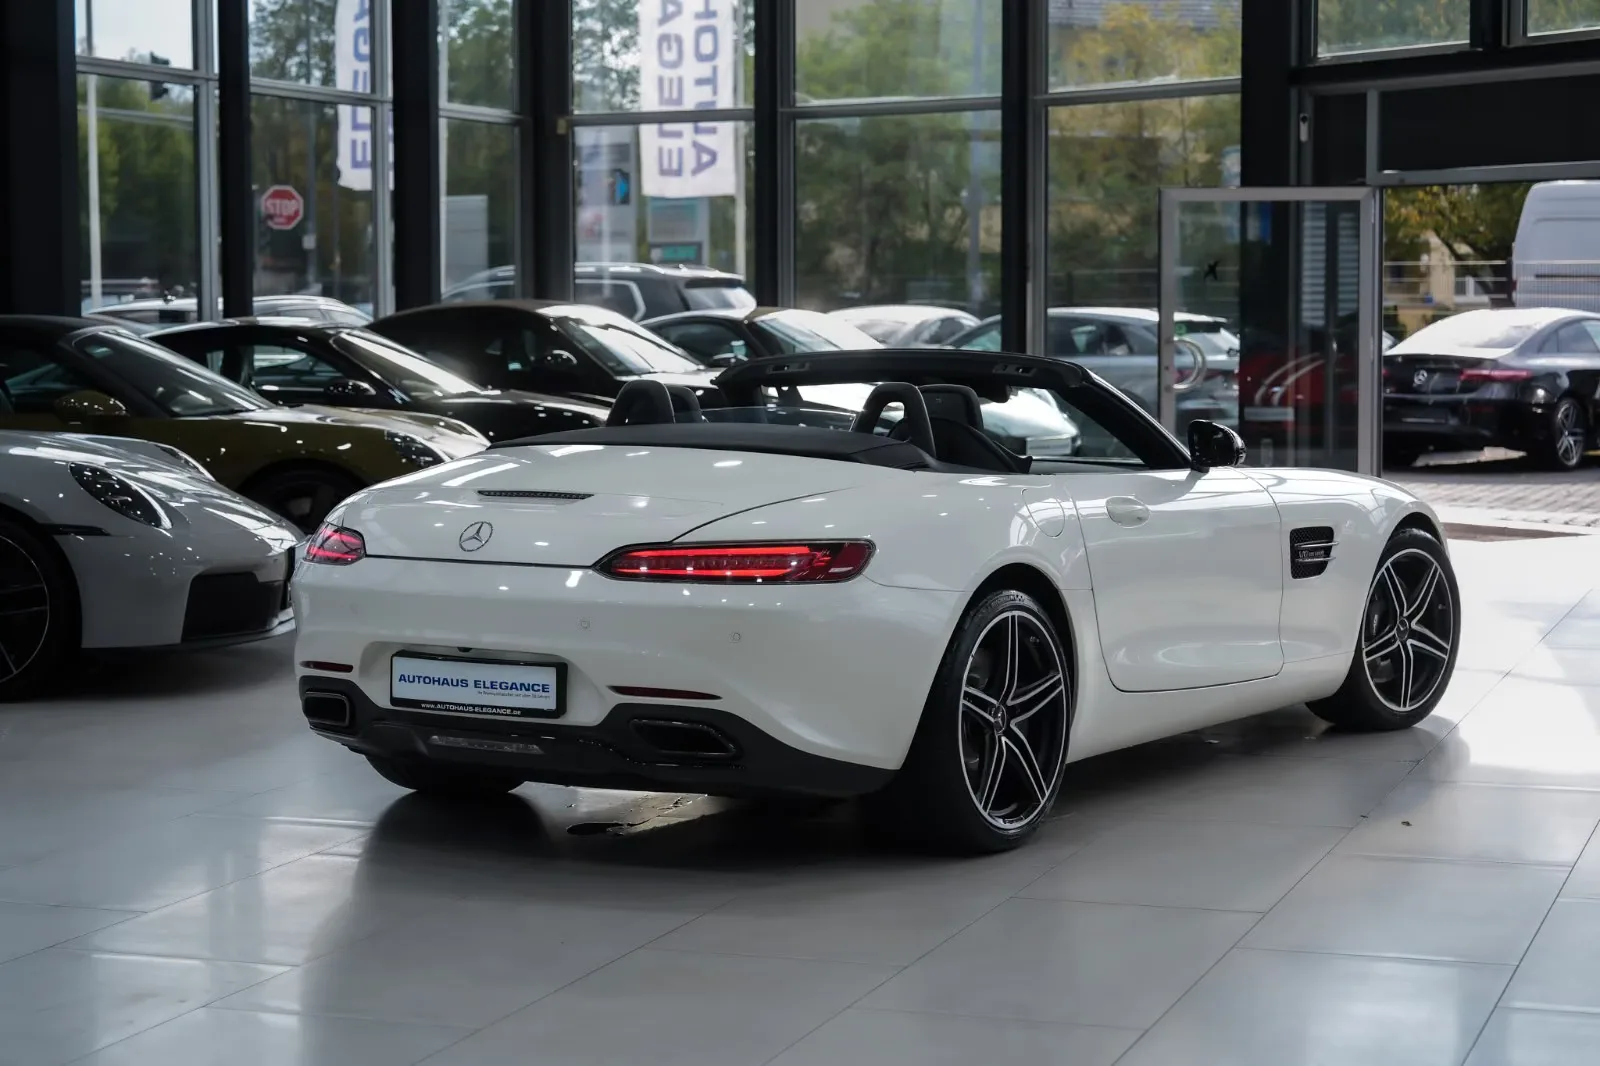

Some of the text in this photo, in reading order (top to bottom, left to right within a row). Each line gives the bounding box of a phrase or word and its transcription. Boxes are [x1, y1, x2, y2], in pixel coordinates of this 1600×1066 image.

[265, 199, 298, 216] STOP
[398, 673, 550, 693] AUTOHAUS ELEGANCE
